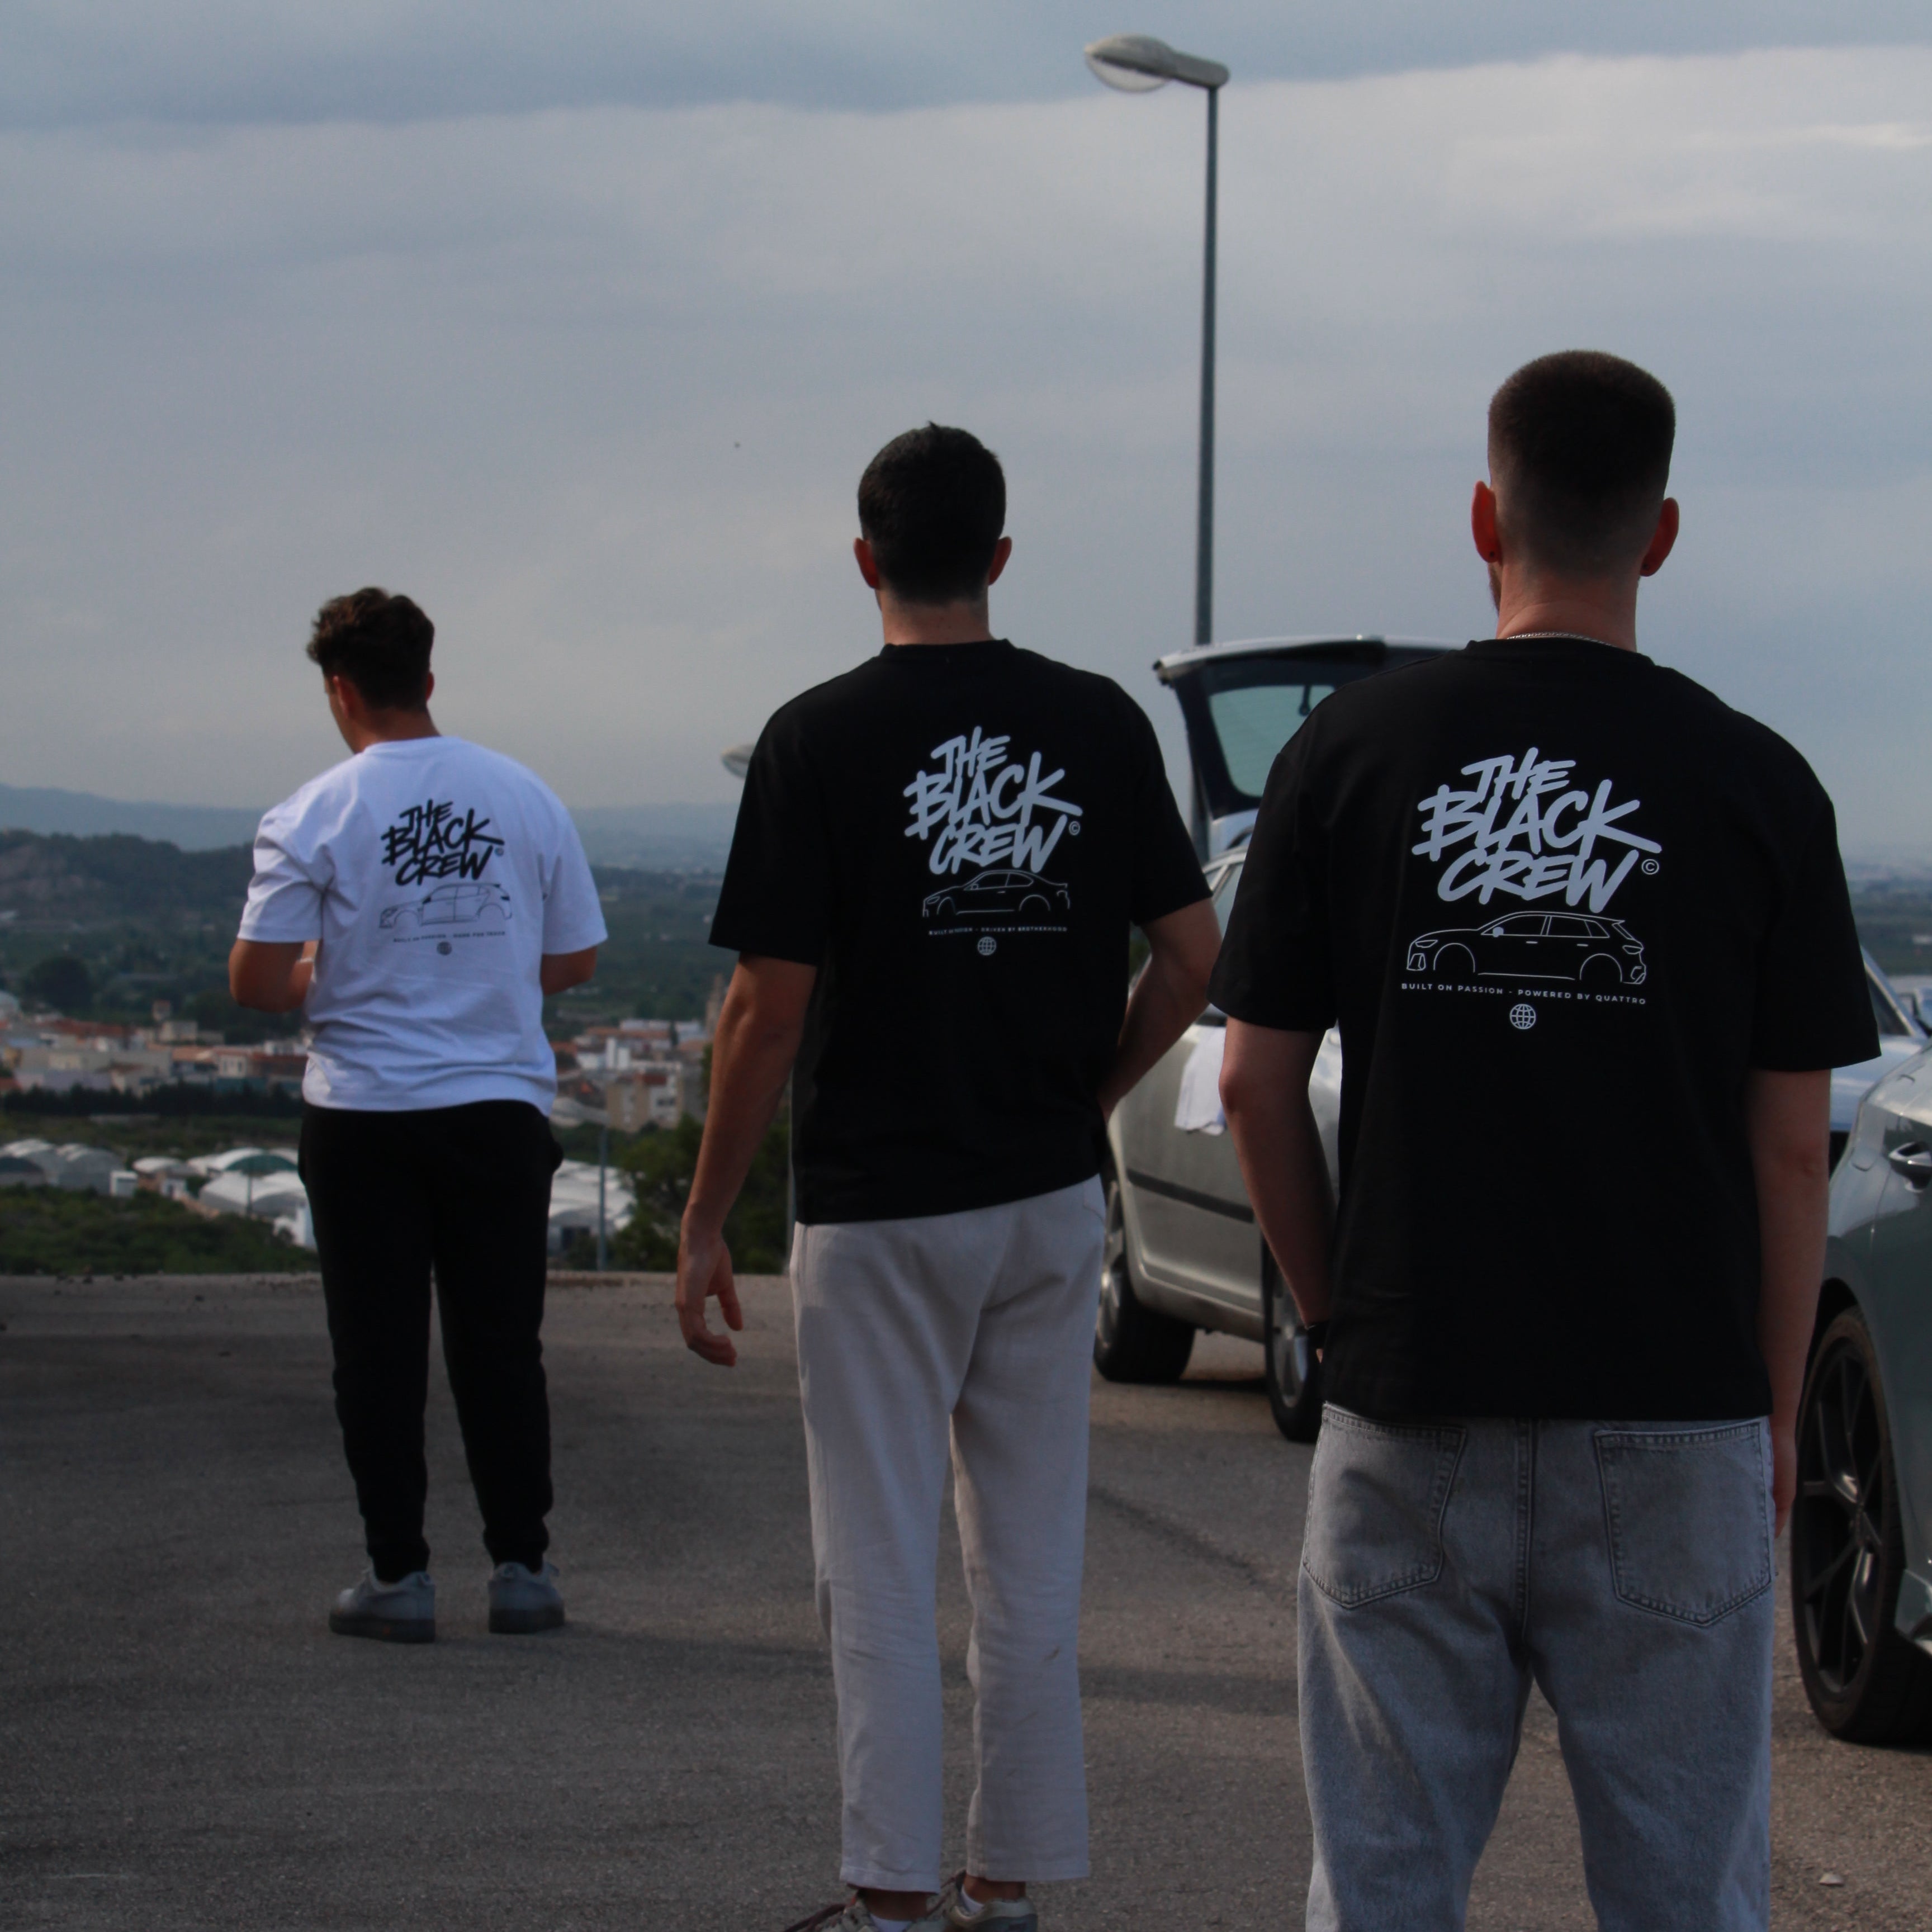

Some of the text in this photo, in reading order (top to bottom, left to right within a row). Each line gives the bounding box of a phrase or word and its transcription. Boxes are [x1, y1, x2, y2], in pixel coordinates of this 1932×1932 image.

[930, 726, 1011, 783] THE
[1461, 747, 1576, 803] THE
[399, 799, 453, 832] THE
[903, 751, 1083, 840] BLACK
[1412, 779, 1662, 866] BLACK
[381, 808, 505, 865] BLACK
[929, 814, 1068, 874] CREW
[396, 845, 494, 886] CREW
[1437, 849, 1639, 913] CREW
[1457, 984, 1503, 995] PASSION
[1517, 989, 1572, 999] POWERED
[1595, 995, 1646, 1005] QUATTRO
